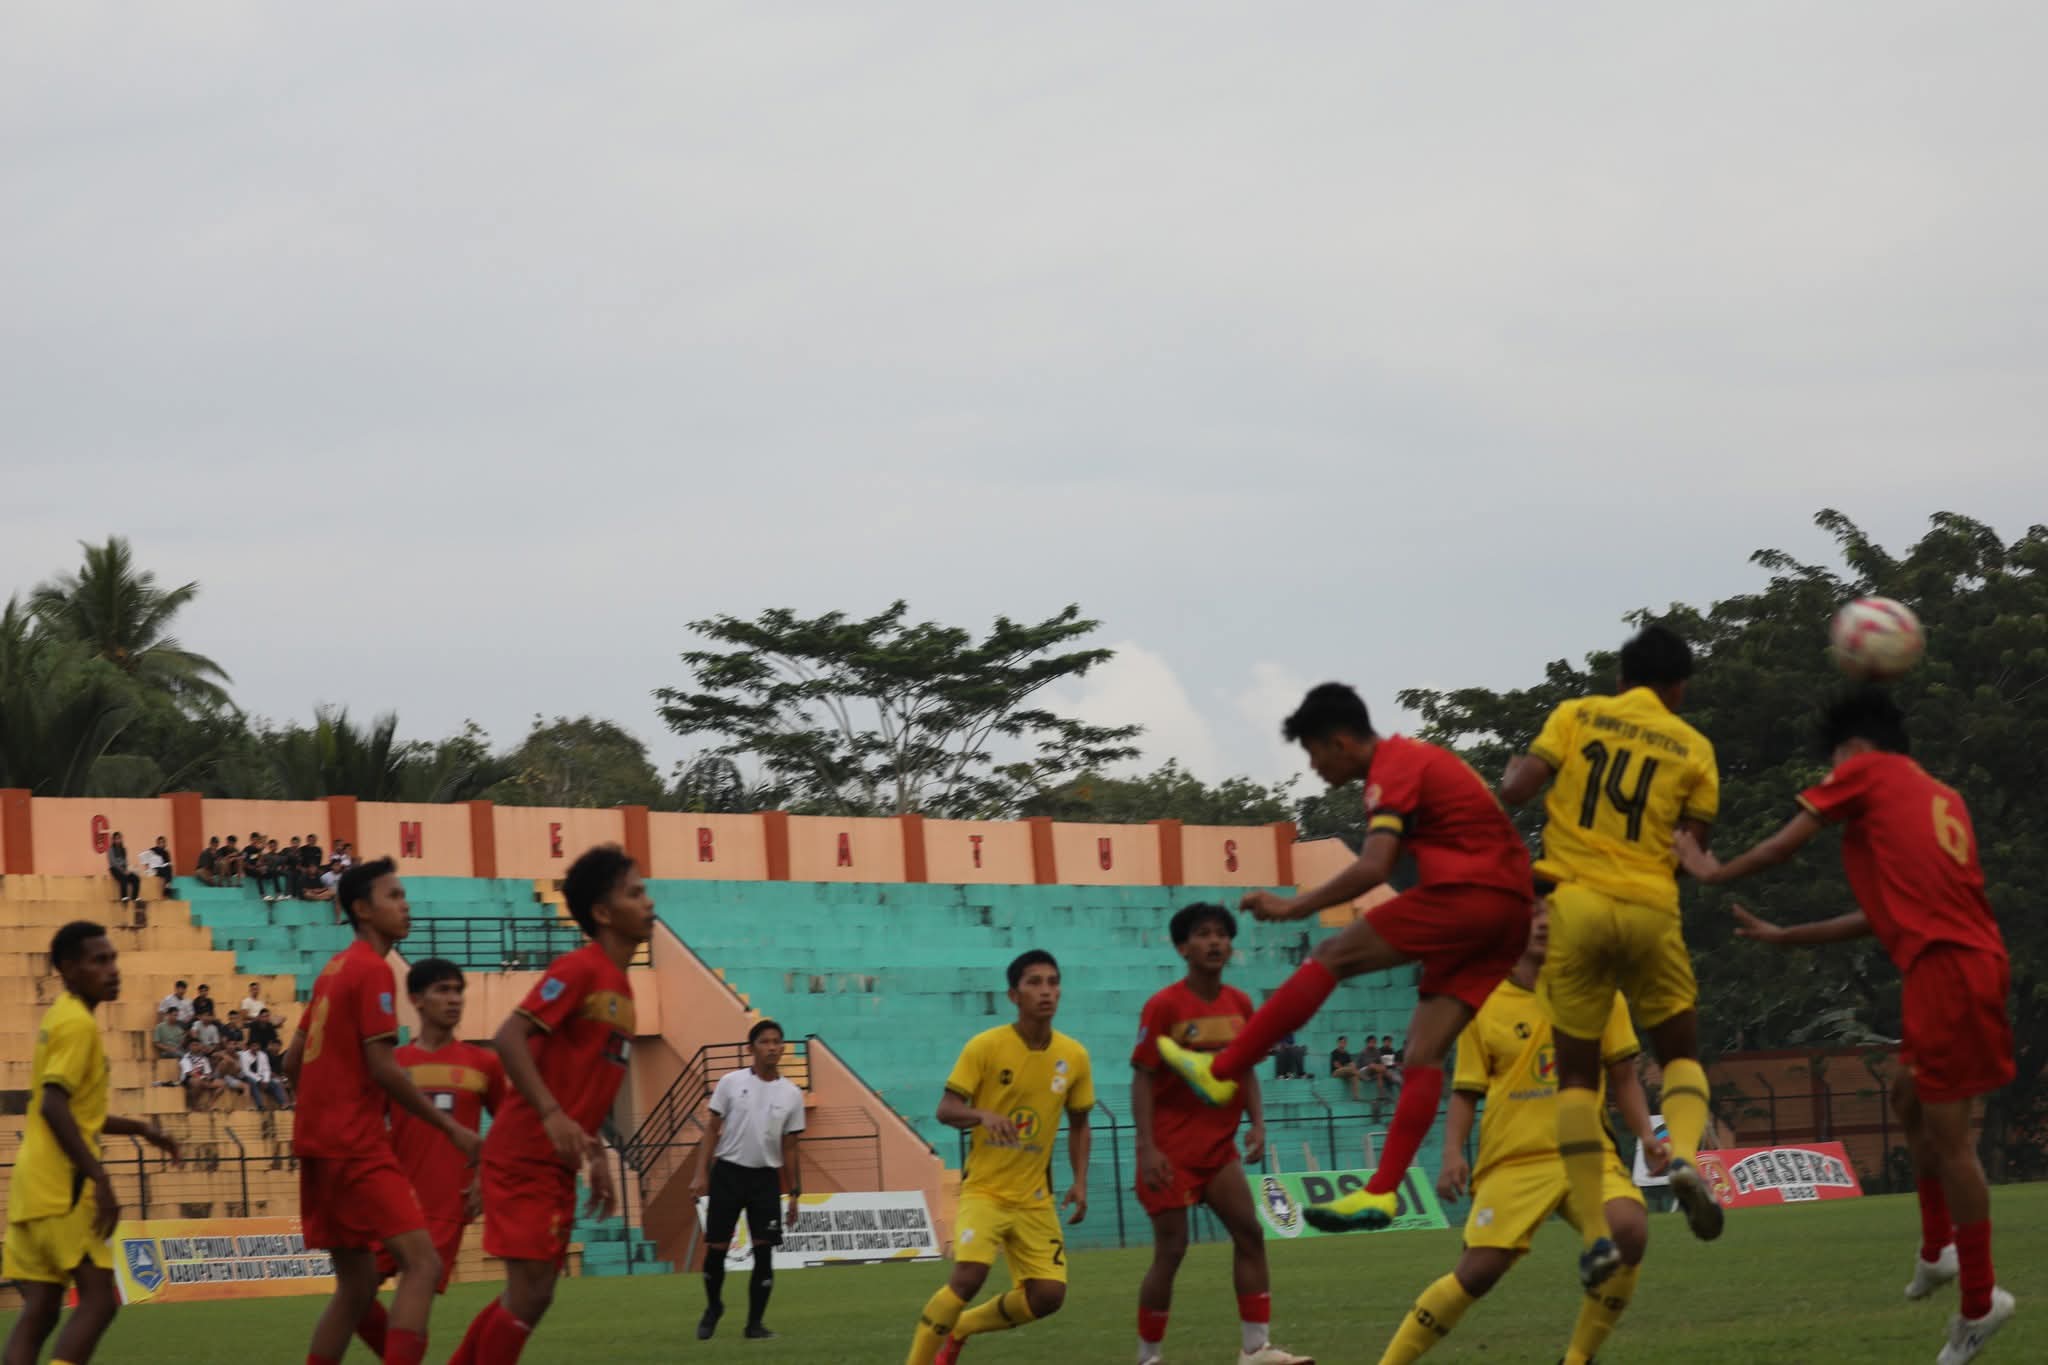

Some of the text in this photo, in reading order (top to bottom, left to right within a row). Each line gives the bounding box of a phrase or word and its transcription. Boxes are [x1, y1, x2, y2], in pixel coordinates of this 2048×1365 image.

[1578, 739, 1659, 842] 14
[1932, 796, 1969, 865] 6
[1733, 1150, 1852, 1193] PERSEKA
[1302, 1173, 1426, 1216] PSI
[831, 1235, 854, 1251] HULU
[856, 1234, 889, 1250] SUNGAI
[891, 1232, 932, 1249] SELATAN
[833, 1210, 877, 1232] NASIONAL
[879, 1208, 928, 1231] INDONESIA
[168, 1262, 233, 1284] KABUPATEN
[235, 1261, 265, 1282] HULU
[266, 1259, 309, 1281] SUNGAI
